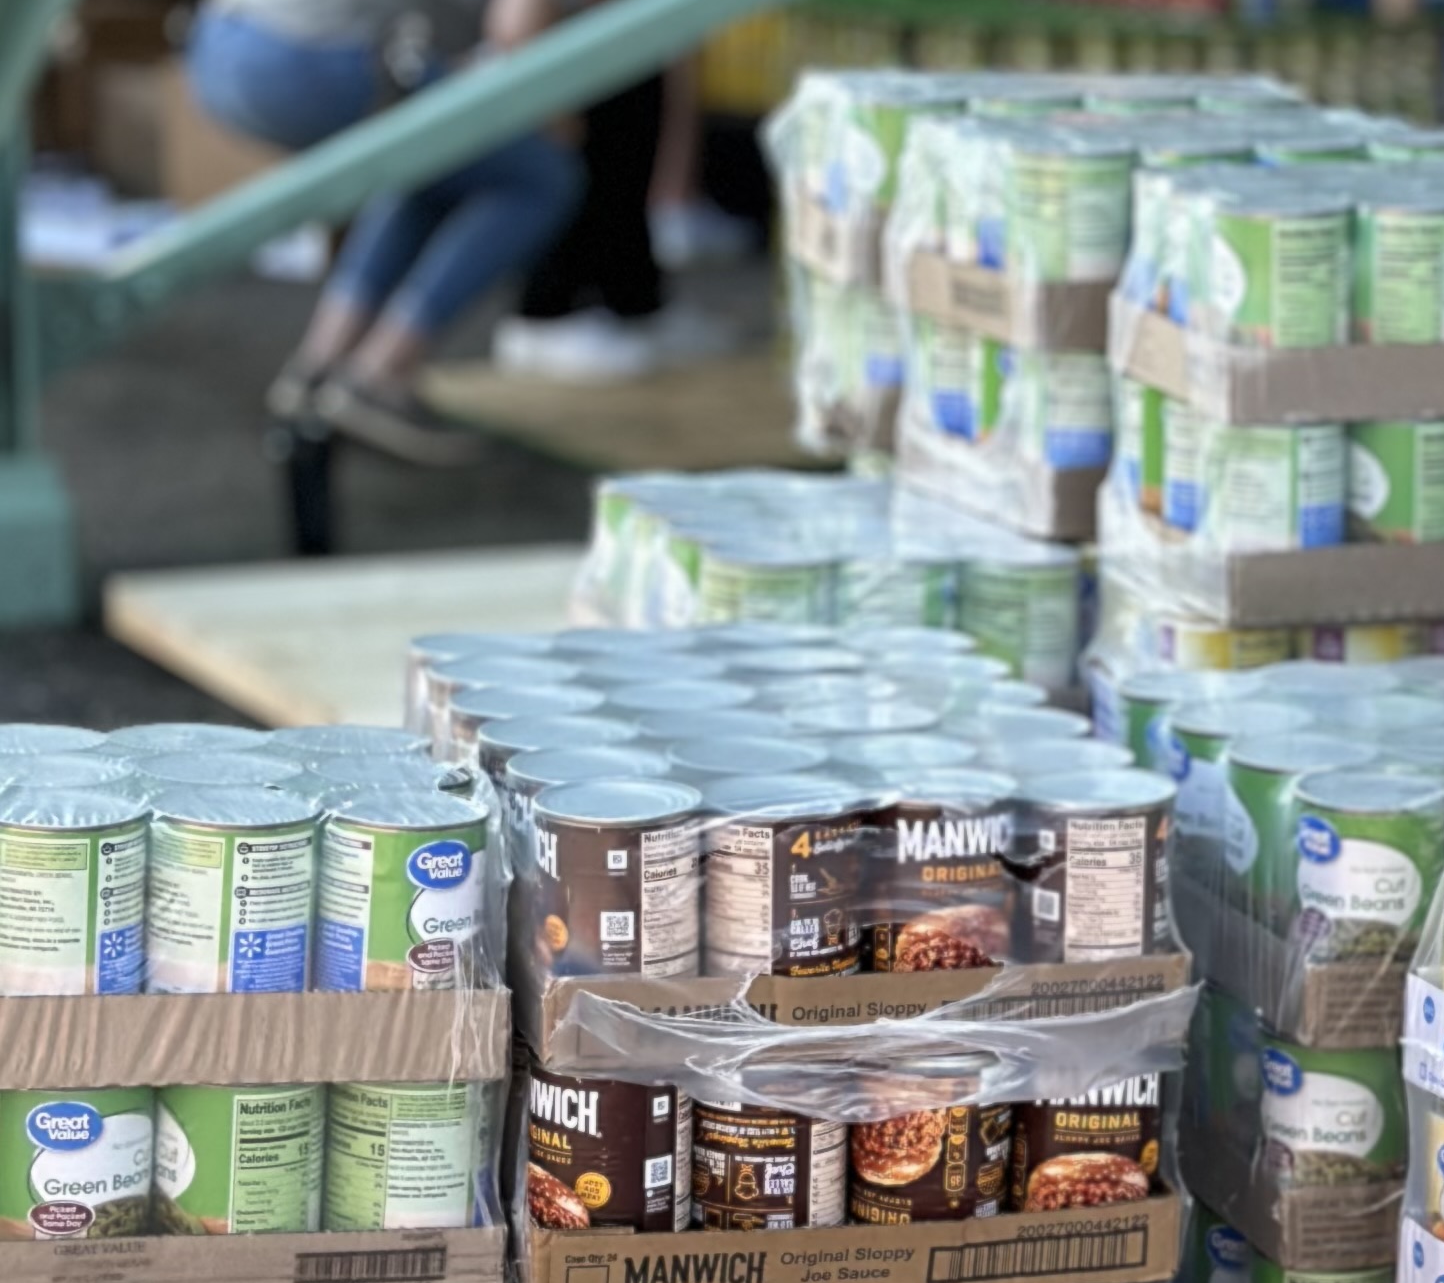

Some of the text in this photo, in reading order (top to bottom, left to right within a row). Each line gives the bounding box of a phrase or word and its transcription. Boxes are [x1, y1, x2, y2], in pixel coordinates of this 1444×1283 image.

[417, 852, 464, 870] Great
[429, 866, 464, 878] Value
[1374, 878, 1406, 895] Cut
[791, 1001, 926, 1021] Original Sloppy
[35, 1113, 90, 1132] Great
[1055, 1113, 1141, 1128] ORIGINAL
[48, 1127, 90, 1140] Value
[239, 1154, 279, 1163] Calories
[44, 1179, 108, 1195] Green
[1016, 1215, 1149, 1236] 20027000442122
[780, 1250, 851, 1265] Original
[856, 1245, 915, 1264] Sloppy
[800, 1265, 890, 1282] Joe Sauce
